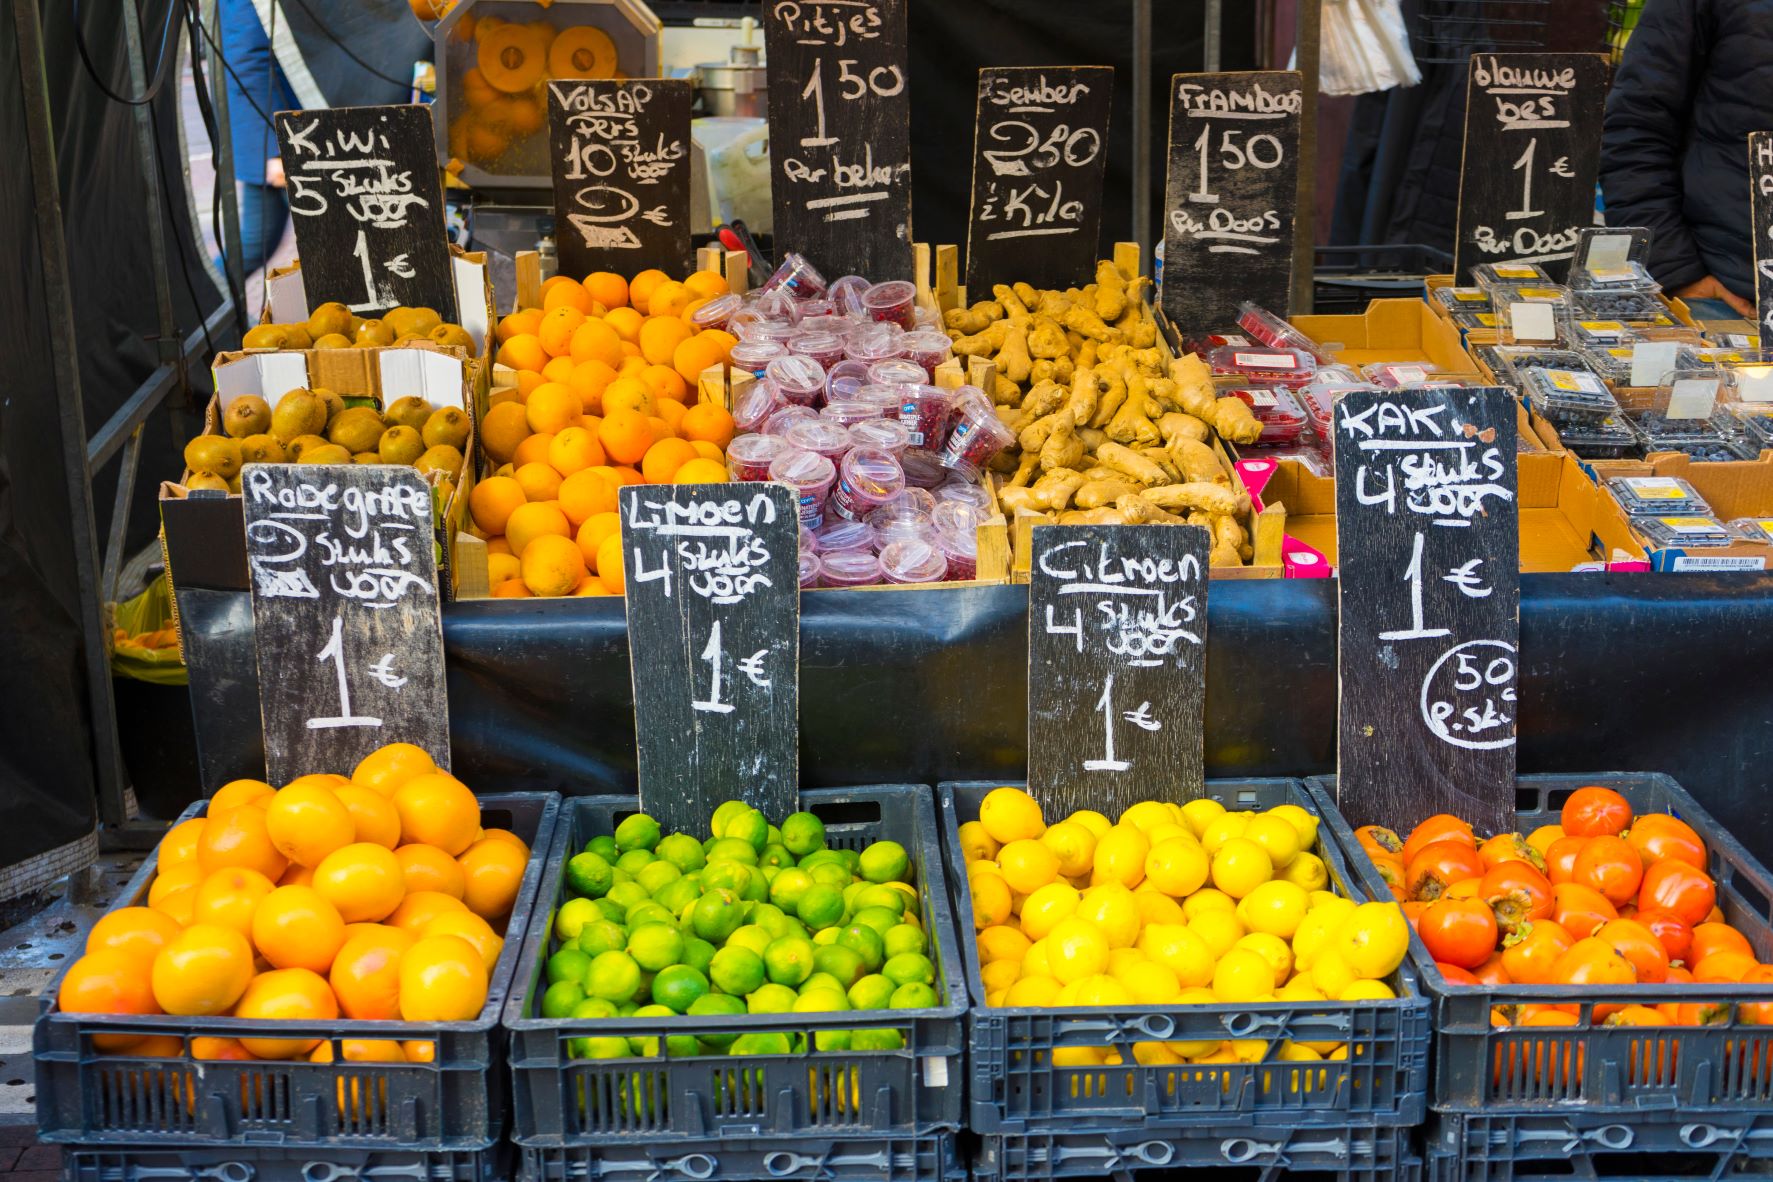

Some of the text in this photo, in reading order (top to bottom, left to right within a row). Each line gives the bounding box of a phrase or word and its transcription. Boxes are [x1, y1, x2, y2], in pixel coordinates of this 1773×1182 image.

[775, 1, 882, 47] Pitjes
[1474, 56, 1576, 88] blauwe
[1495, 96, 1556, 123] bes
[283, 115, 391, 157] Kiwi
[564, 135, 617, 180] 10
[289, 175, 329, 217] 5
[1506, 137, 1576, 220] 1 €
[567, 185, 673, 248] 2 €
[347, 229, 417, 313] 1 €
[1356, 463, 1396, 514] 4
[247, 519, 321, 598] 2
[633, 546, 674, 598] 4
[1038, 541, 1201, 584] Citroen
[1378, 531, 1493, 640] 1 €
[1046, 604, 1083, 654] 4
[305, 615, 408, 729] 1 €
[690, 619, 772, 714] 1 €
[1454, 653, 1515, 691] 50
[1082, 672, 1162, 771] 1 €
